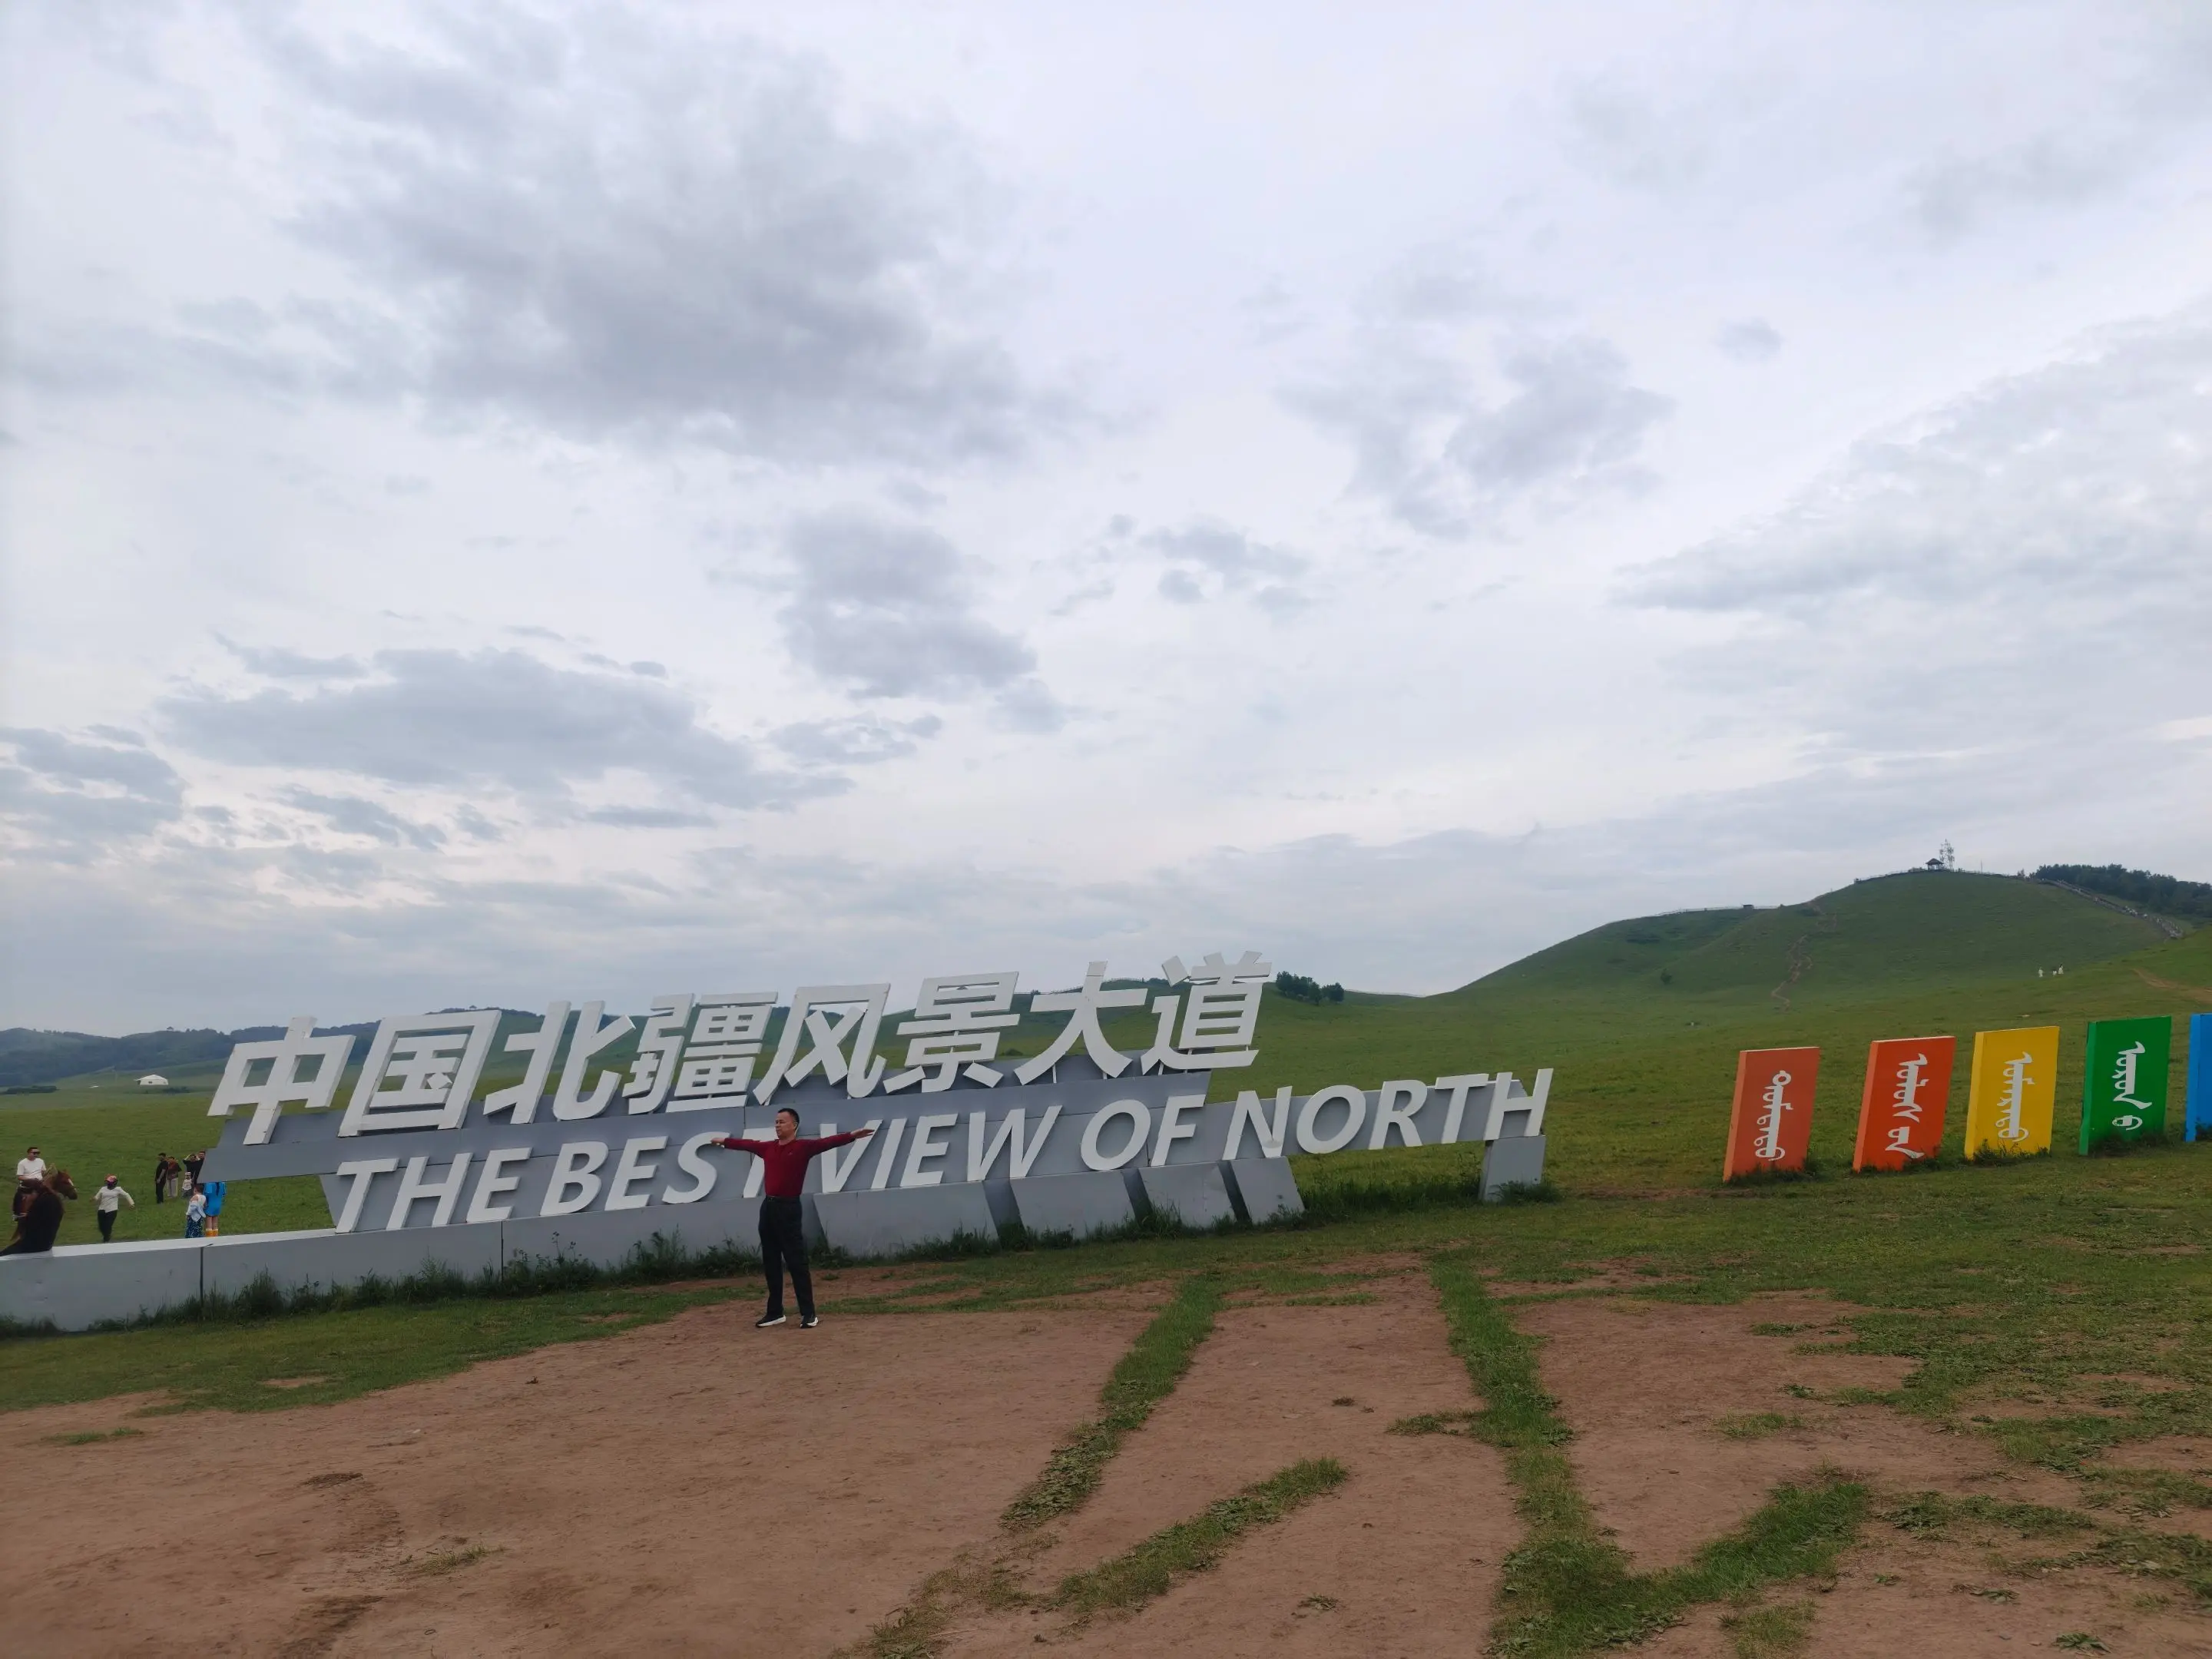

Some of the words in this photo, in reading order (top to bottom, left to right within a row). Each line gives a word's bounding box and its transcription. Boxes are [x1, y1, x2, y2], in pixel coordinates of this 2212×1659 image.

[207, 950, 1272, 1145] 中国北疆风景大道
[335, 1147, 533, 1233] THE
[820, 1104, 1062, 1194] VIEW
[1080, 1093, 1207, 1171] OF
[1222, 1068, 1553, 1160] NORTH
